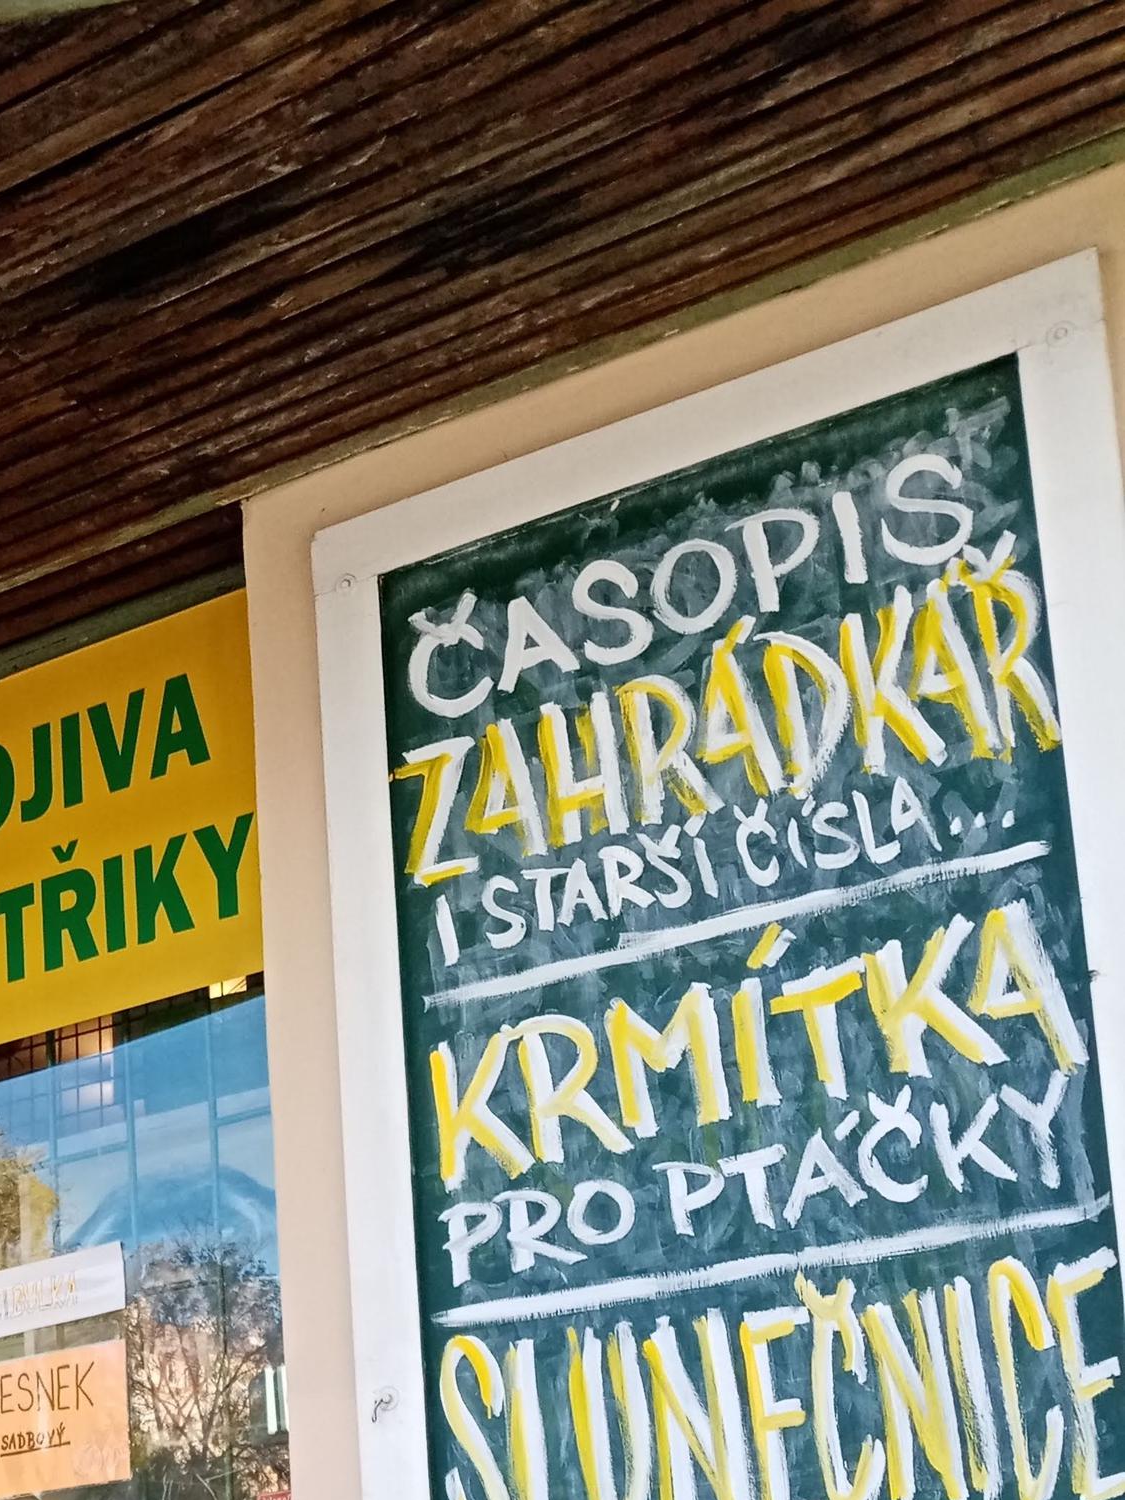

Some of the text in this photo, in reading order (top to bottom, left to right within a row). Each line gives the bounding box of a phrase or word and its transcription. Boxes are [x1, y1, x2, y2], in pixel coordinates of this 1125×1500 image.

[389, 531, 1062, 886] ZAHRÁDKÁŘ
[408, 453, 974, 717] ČASOPIS
[435, 895, 460, 966] I
[485, 813, 718, 950] STARŠÍ
[430, 900, 1087, 1191] KRMÍTKA
[438, 1069, 1070, 1287] PRO PTÁČKY
